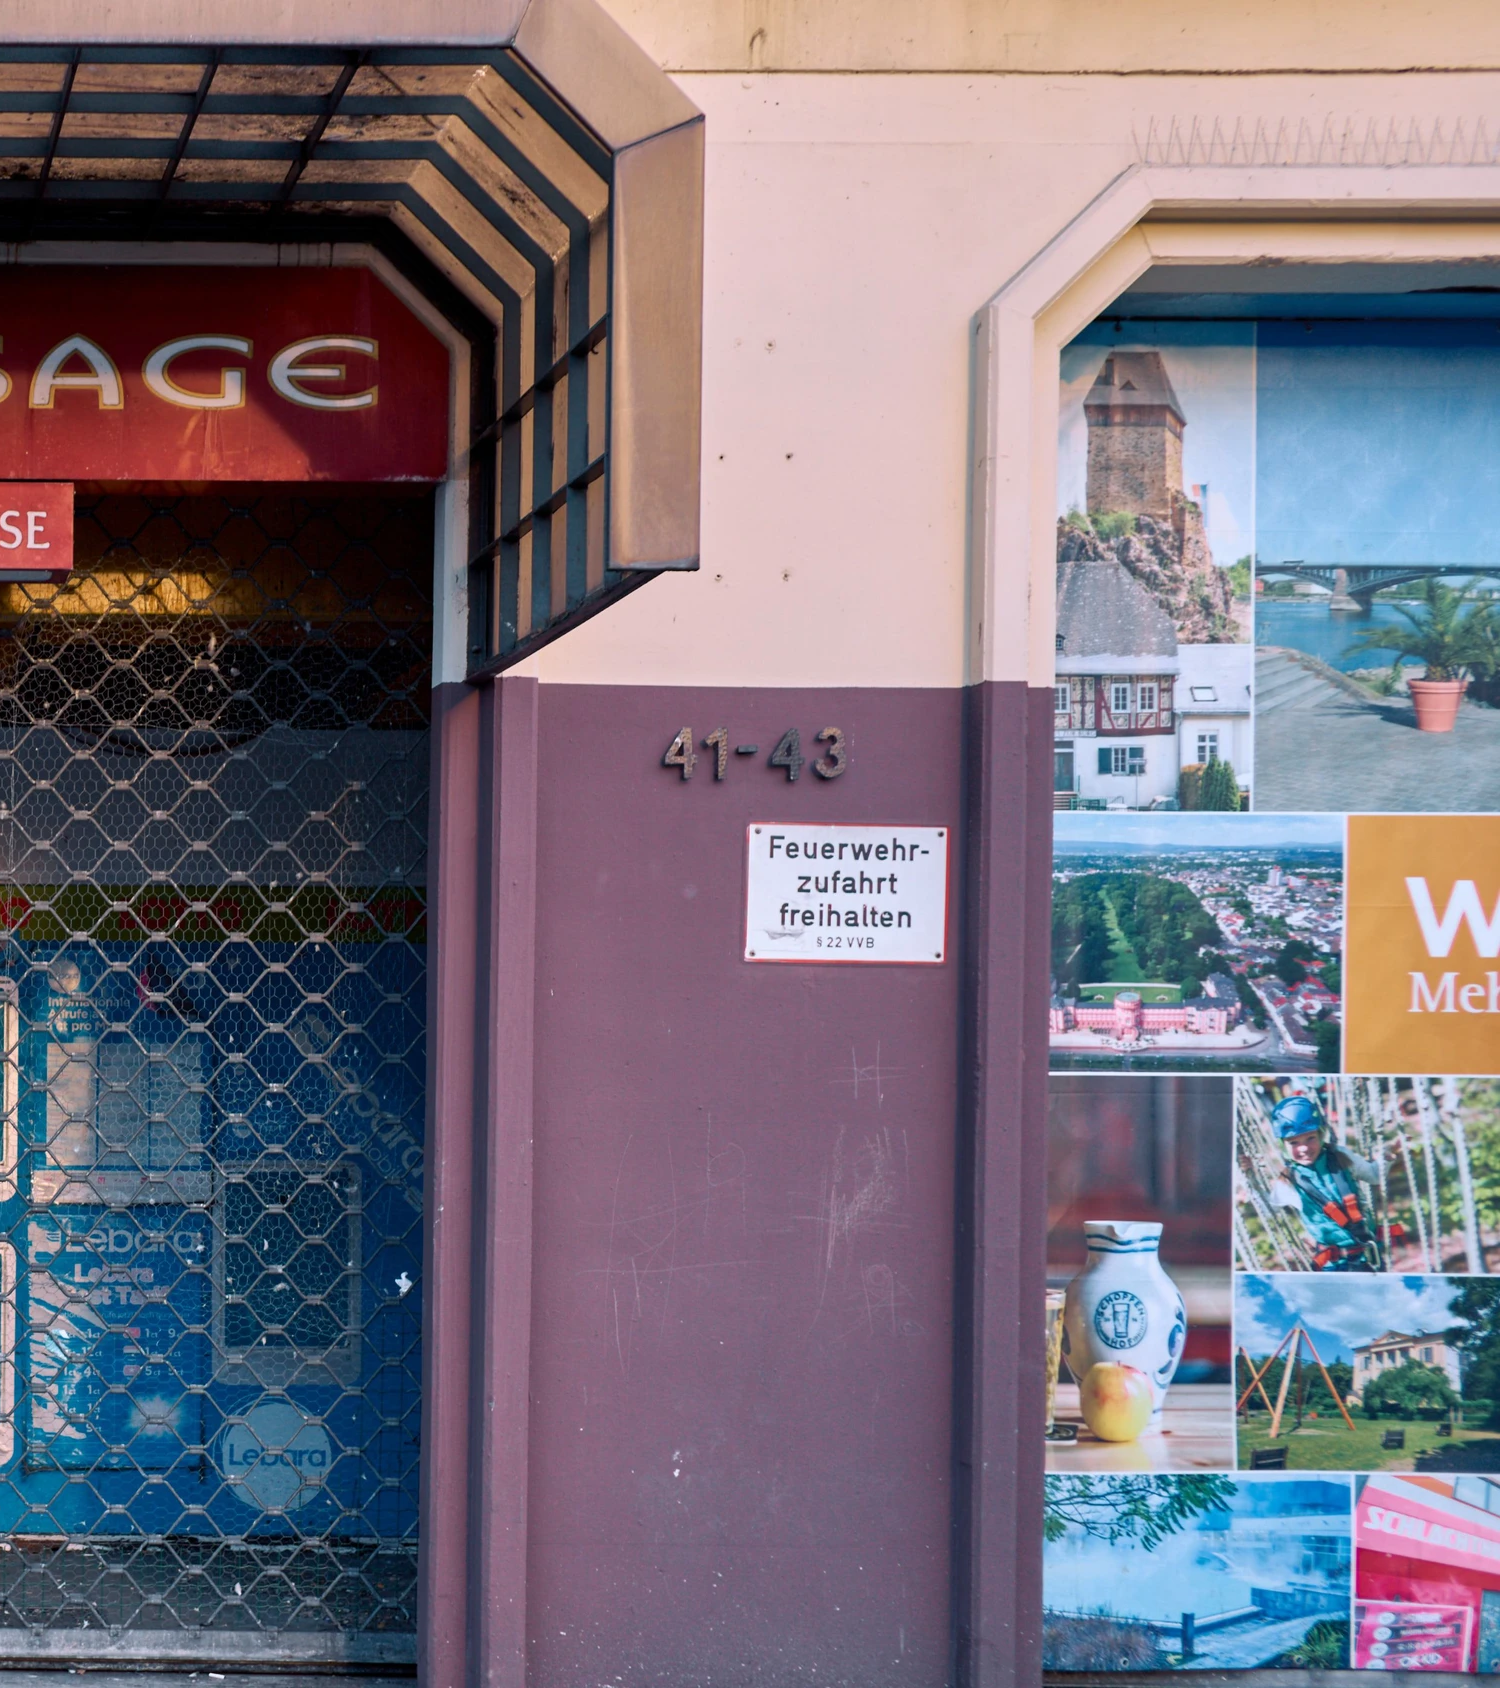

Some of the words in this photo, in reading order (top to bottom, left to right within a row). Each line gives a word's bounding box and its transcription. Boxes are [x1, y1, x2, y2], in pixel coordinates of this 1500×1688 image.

[663, 727, 847, 779] 41-43
[769, 835, 930, 862] Feuerwehr-
[797, 870, 898, 894] zufahrt
[779, 902, 912, 928] freihalten
[827, 937, 842, 948] 22
[847, 937, 875, 949] VVB
[71, 1023, 92, 1033] pro
[66, 1228, 204, 1253] Lebara
[228, 1443, 326, 1468] Lebara
